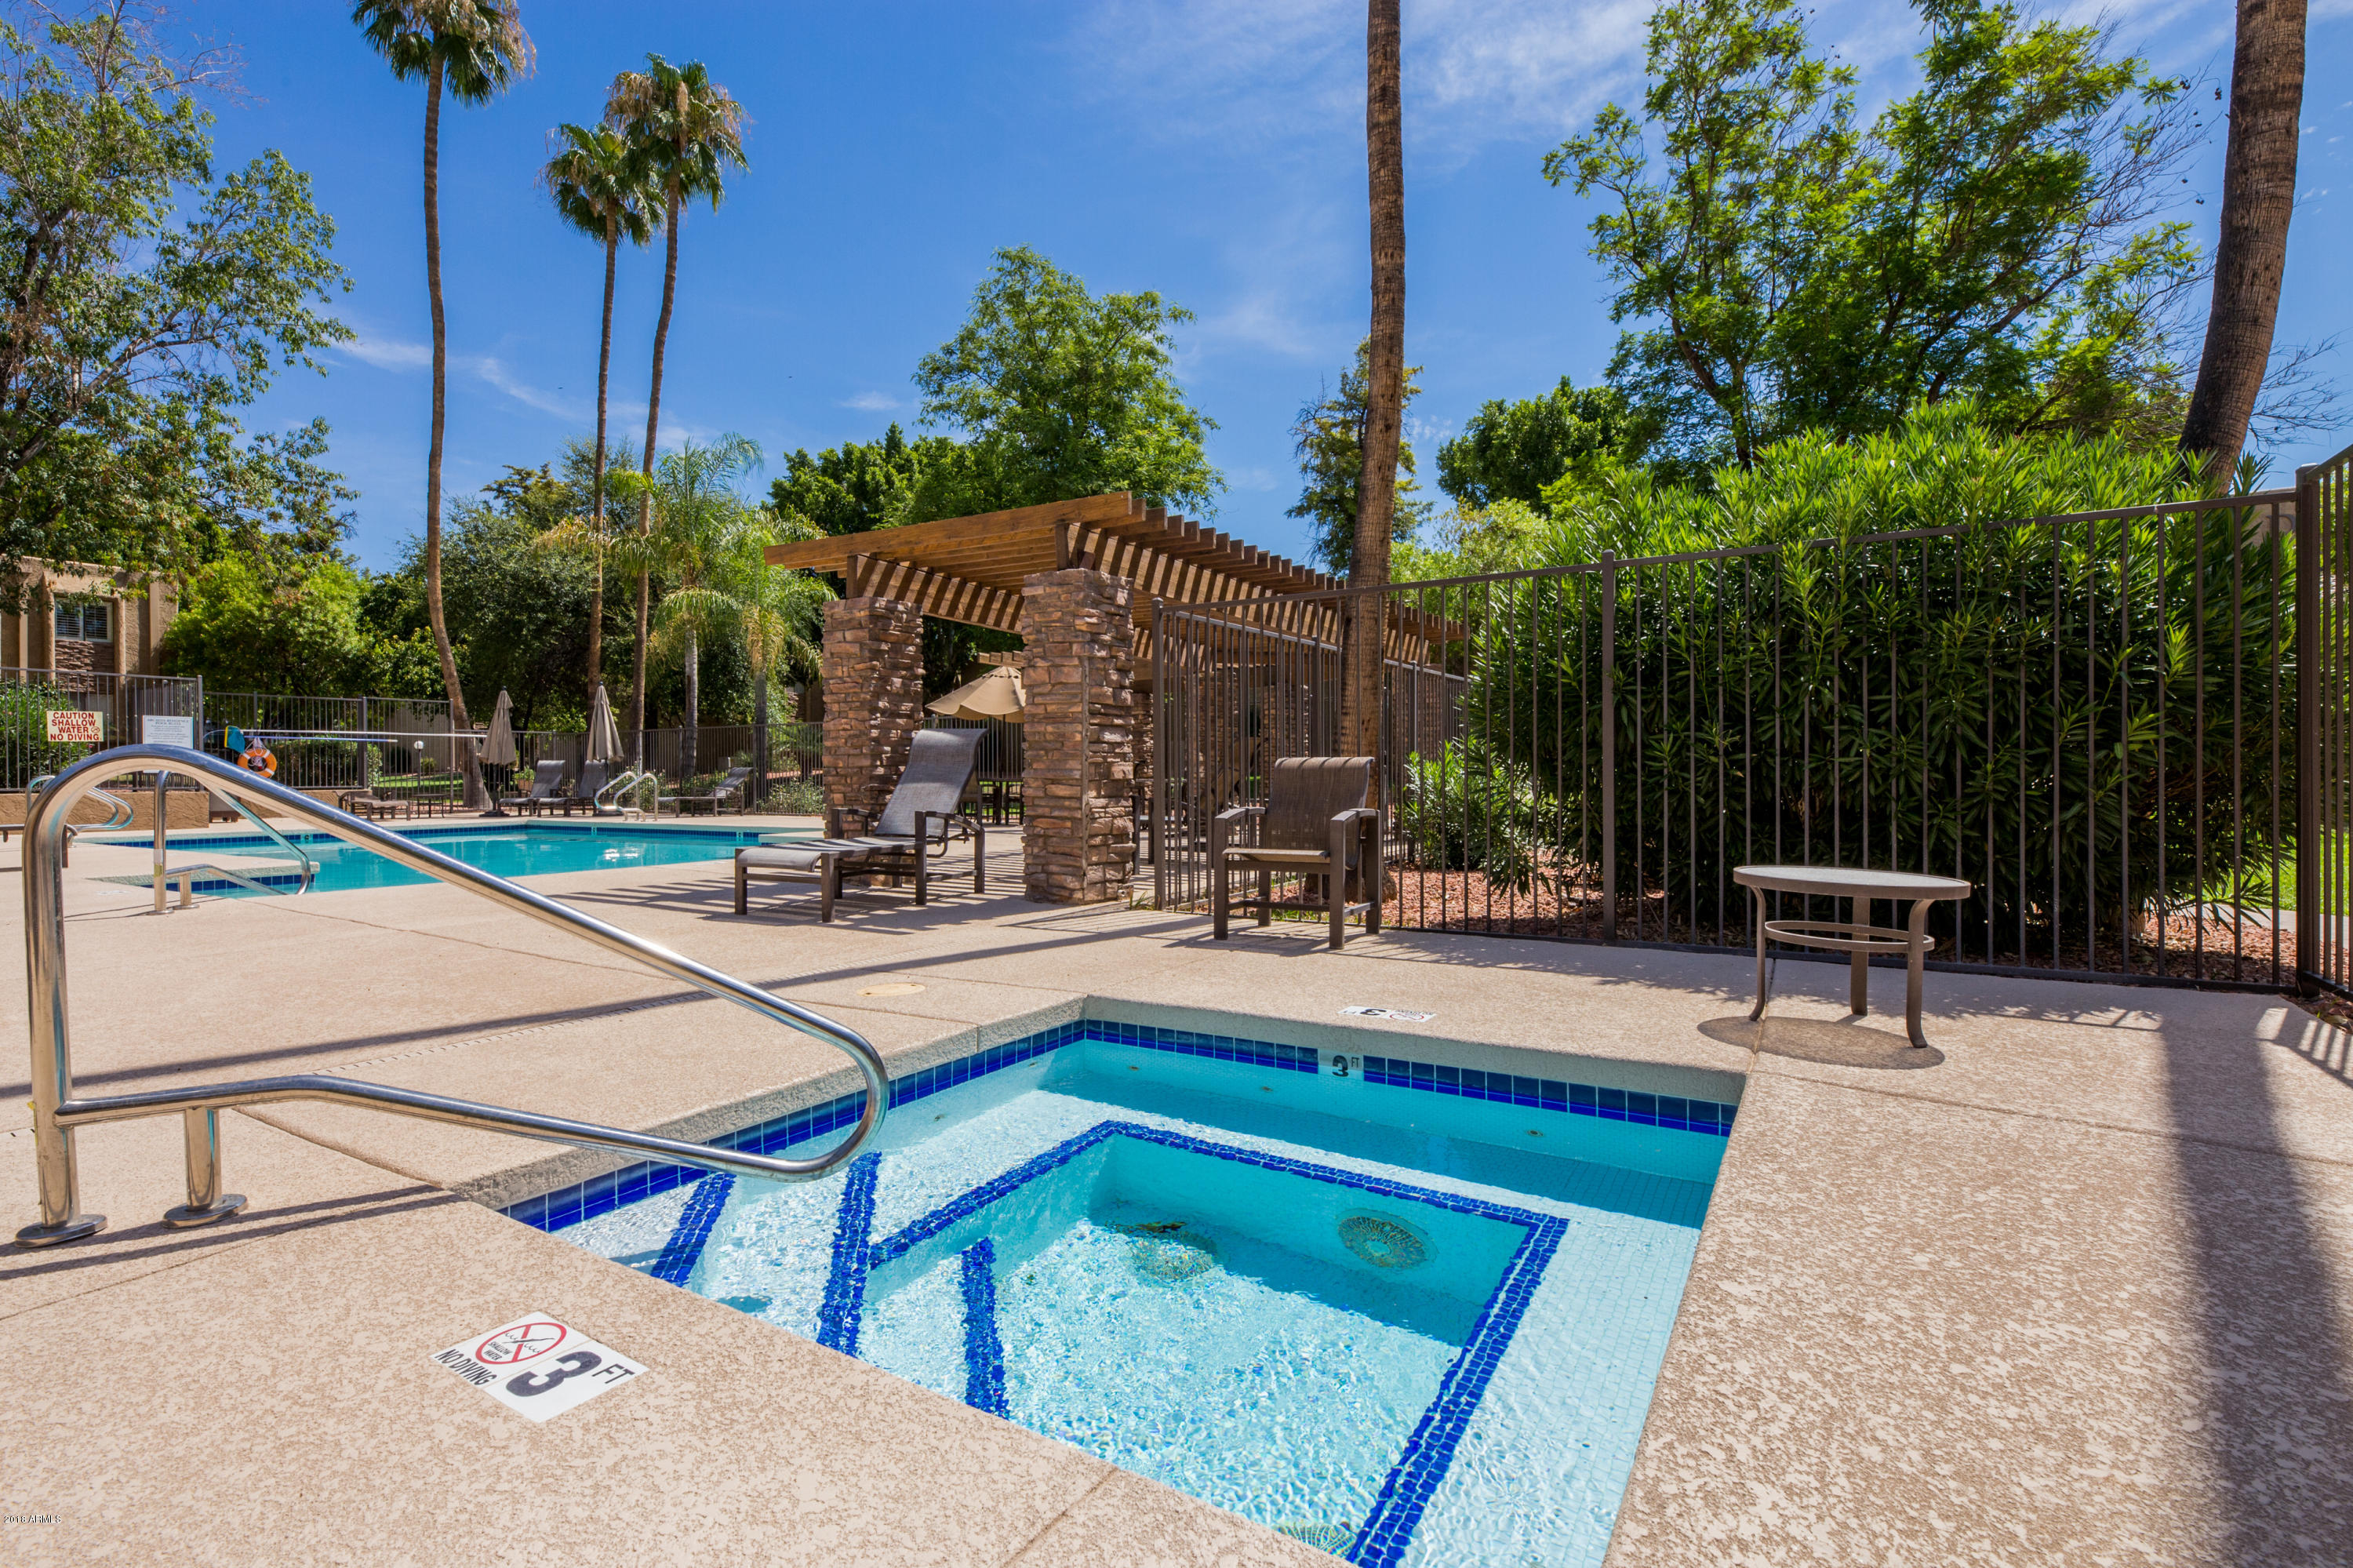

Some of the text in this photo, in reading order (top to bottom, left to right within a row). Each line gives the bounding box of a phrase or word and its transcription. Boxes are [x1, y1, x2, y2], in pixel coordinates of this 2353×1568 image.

[1332, 1055, 1360, 1077] 3 FT
[484, 1349, 503, 1361] WATER
[487, 1341, 514, 1355] SHALLOW
[435, 1349, 497, 1385] NO DIVING
[506, 1351, 635, 1397] 3 FT
